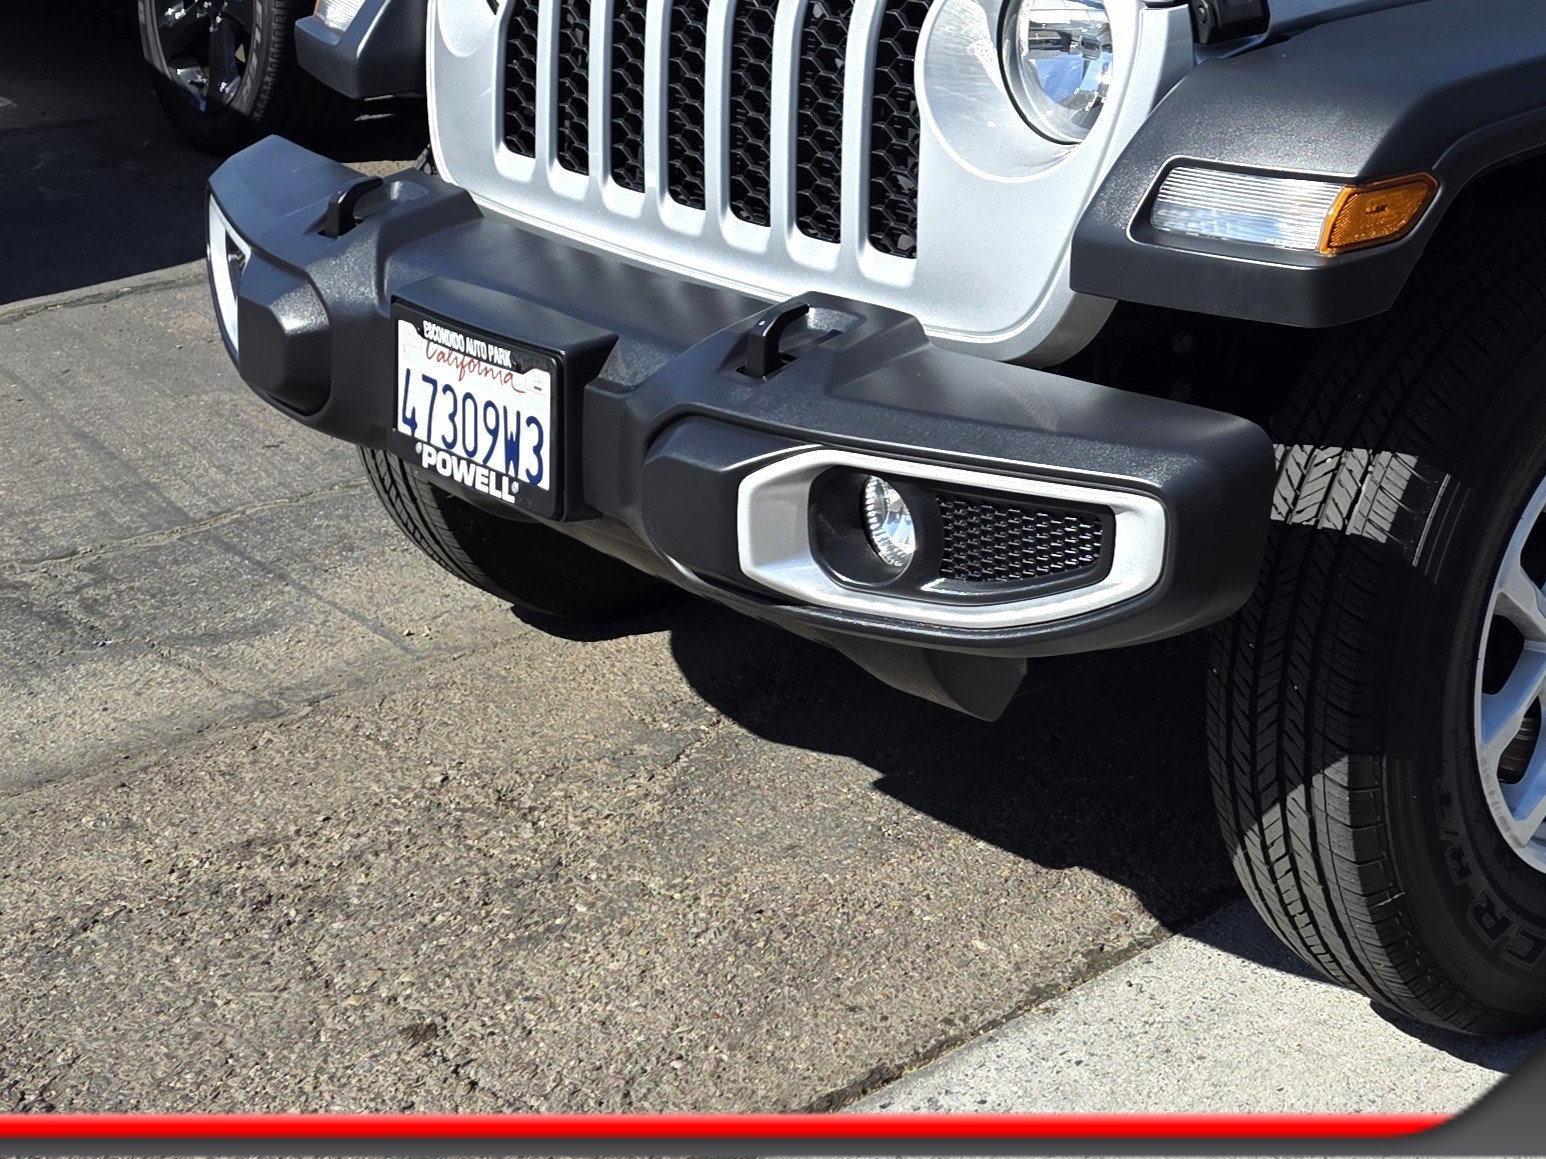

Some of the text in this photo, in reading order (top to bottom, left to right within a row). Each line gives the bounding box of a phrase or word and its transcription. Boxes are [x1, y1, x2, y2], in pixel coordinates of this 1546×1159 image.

[423, 320, 512, 368] ESCONDIDO AUTO PARK
[402, 368, 544, 486] 47309W3
[421, 443, 516, 504] POWELL
